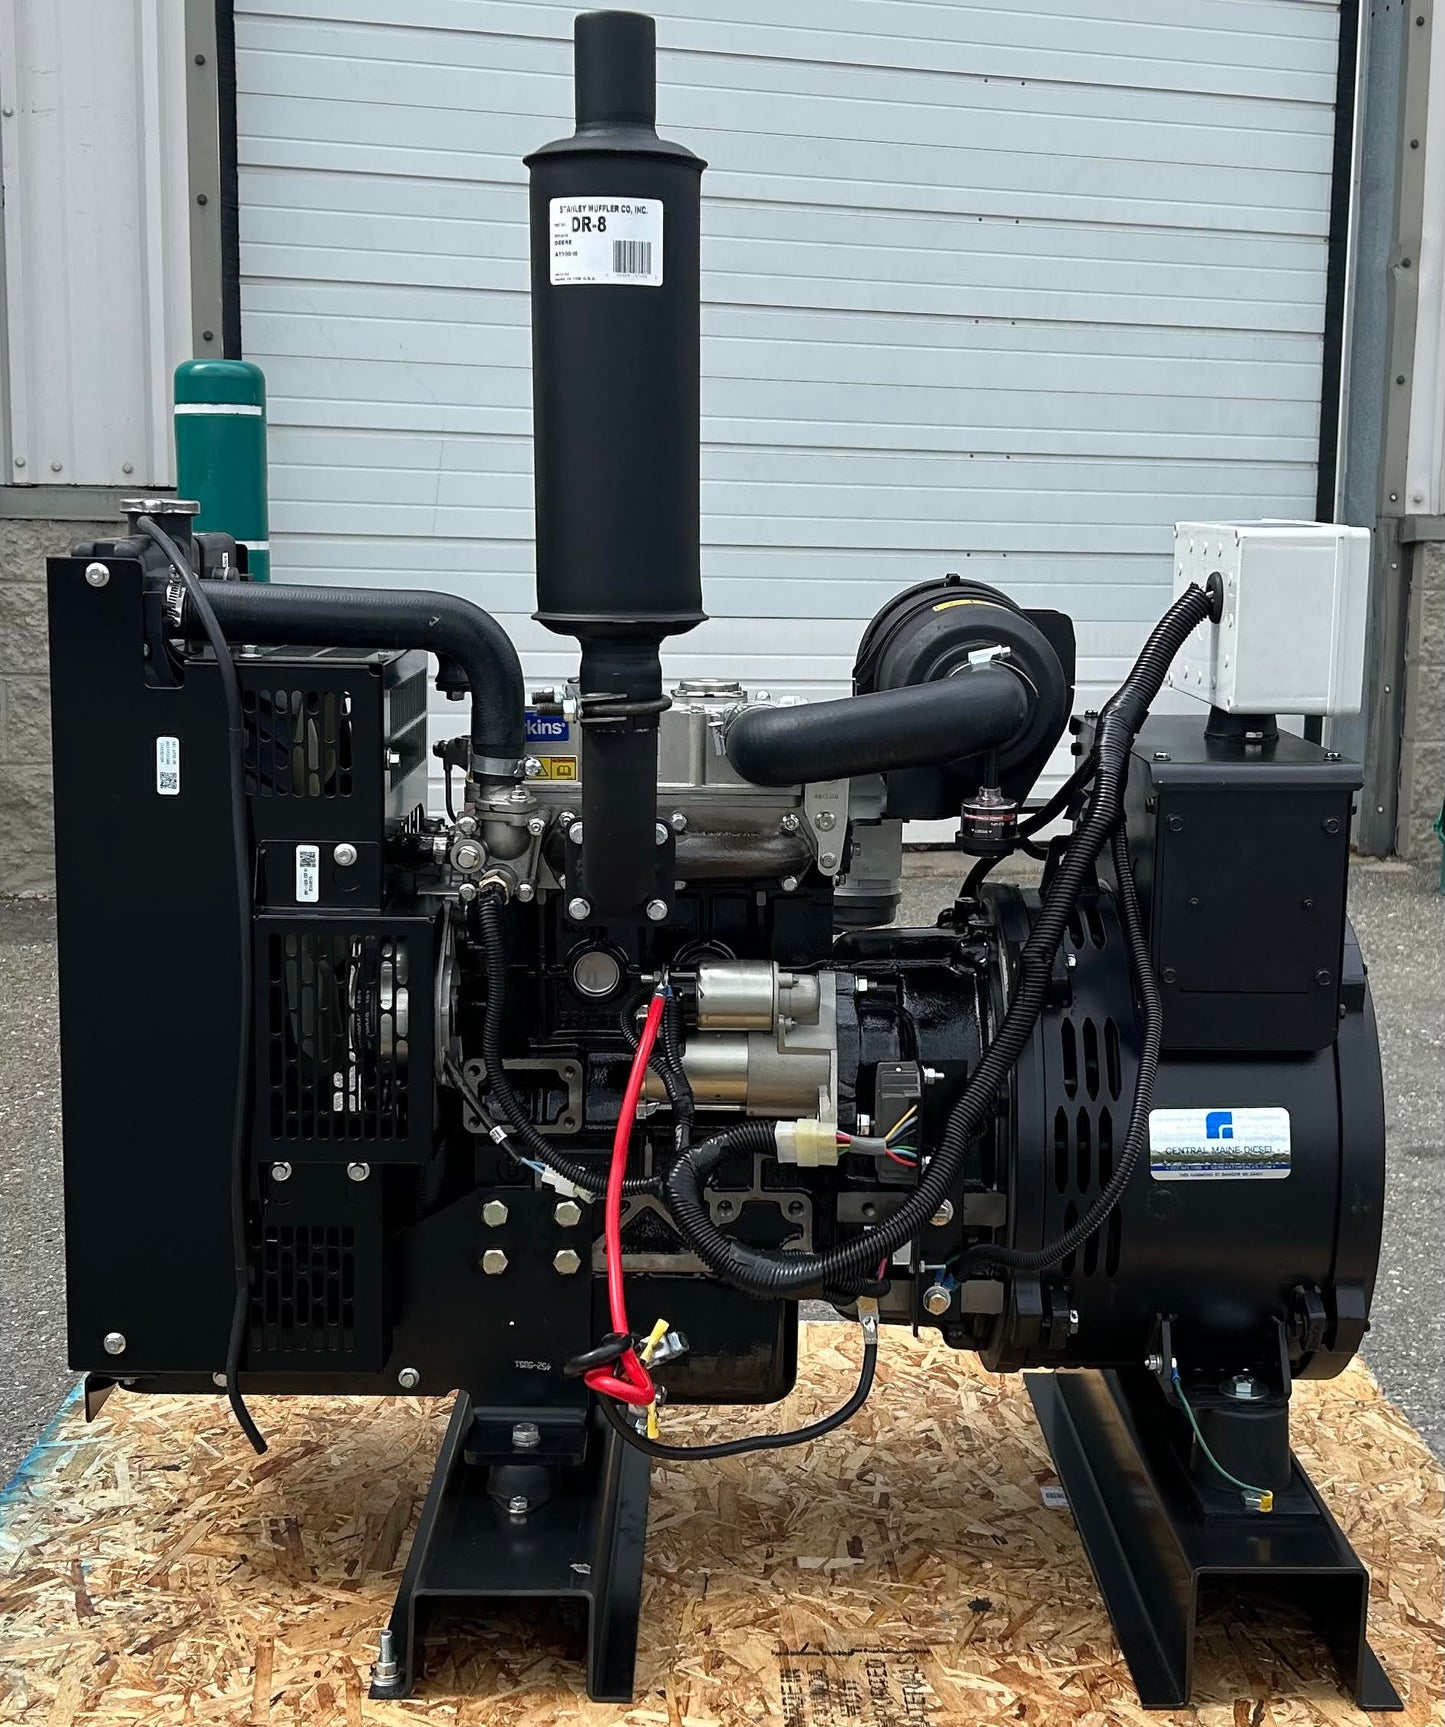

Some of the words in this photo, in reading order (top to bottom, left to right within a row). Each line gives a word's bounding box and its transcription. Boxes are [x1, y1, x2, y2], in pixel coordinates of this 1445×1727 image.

[559, 204, 587, 214] STANLEY
[588, 204, 620, 214] MUFFLER
[621, 205, 633, 215] CO,
[634, 206, 649, 215] INC.
[572, 215, 607, 233] DR-8
[525, 718, 563, 735] kins
[1165, 1146, 1208, 1155] CENTRAL
[1211, 1146, 1242, 1154] MAINE
[1243, 1145, 1274, 1154] DIESEL
